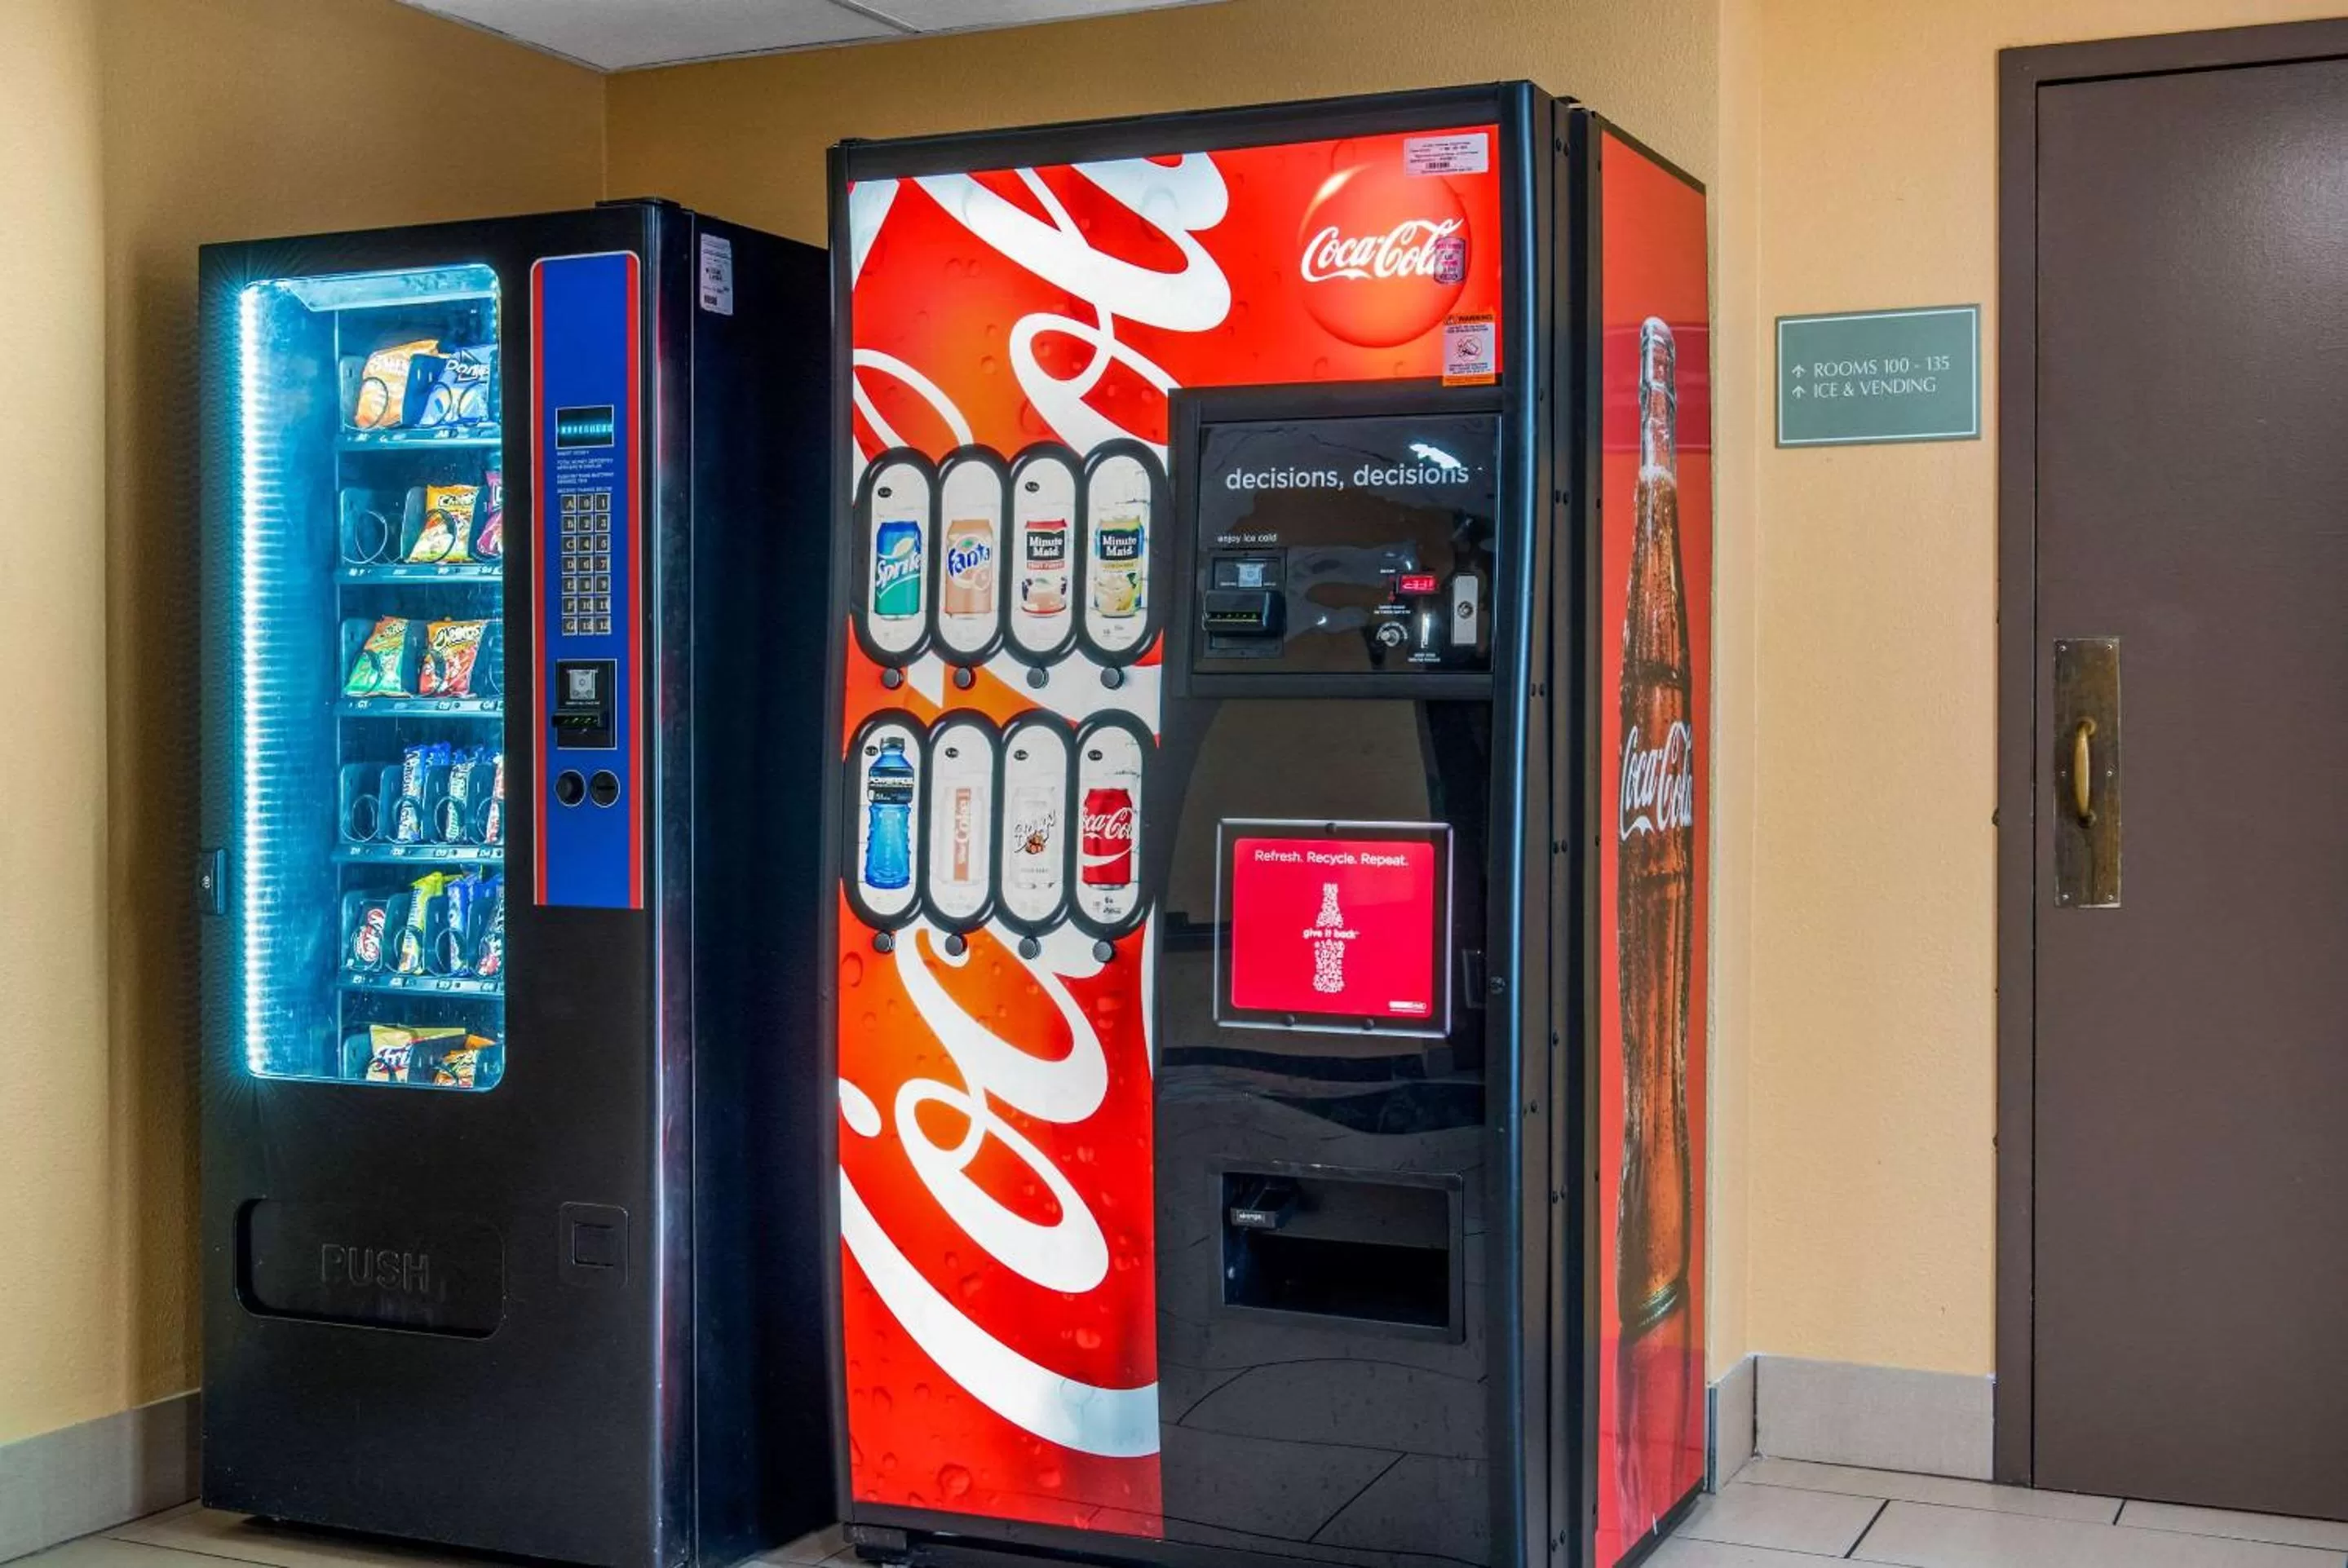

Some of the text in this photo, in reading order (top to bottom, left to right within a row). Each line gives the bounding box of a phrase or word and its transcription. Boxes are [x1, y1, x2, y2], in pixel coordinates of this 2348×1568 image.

[1813, 360, 1877, 378] ROOMS
[1884, 357, 1909, 373] 100
[1926, 356, 1951, 371] 135
[1813, 377, 1937, 398] ICE & VENDING
[1226, 463, 1469, 491] decisions, decisions
[1029, 537, 1063, 546] Minute
[1103, 535, 1137, 545] Minute
[1258, 533, 1278, 541] cold
[1033, 546, 1060, 556] Maid
[1106, 545, 1133, 555] Maid
[1620, 721, 1693, 841] Coca-Cola
[1254, 850, 1409, 867] Refresh. Recycle. Repeat.
[1302, 930, 1323, 939] give
[321, 1243, 431, 1293] PUSH
